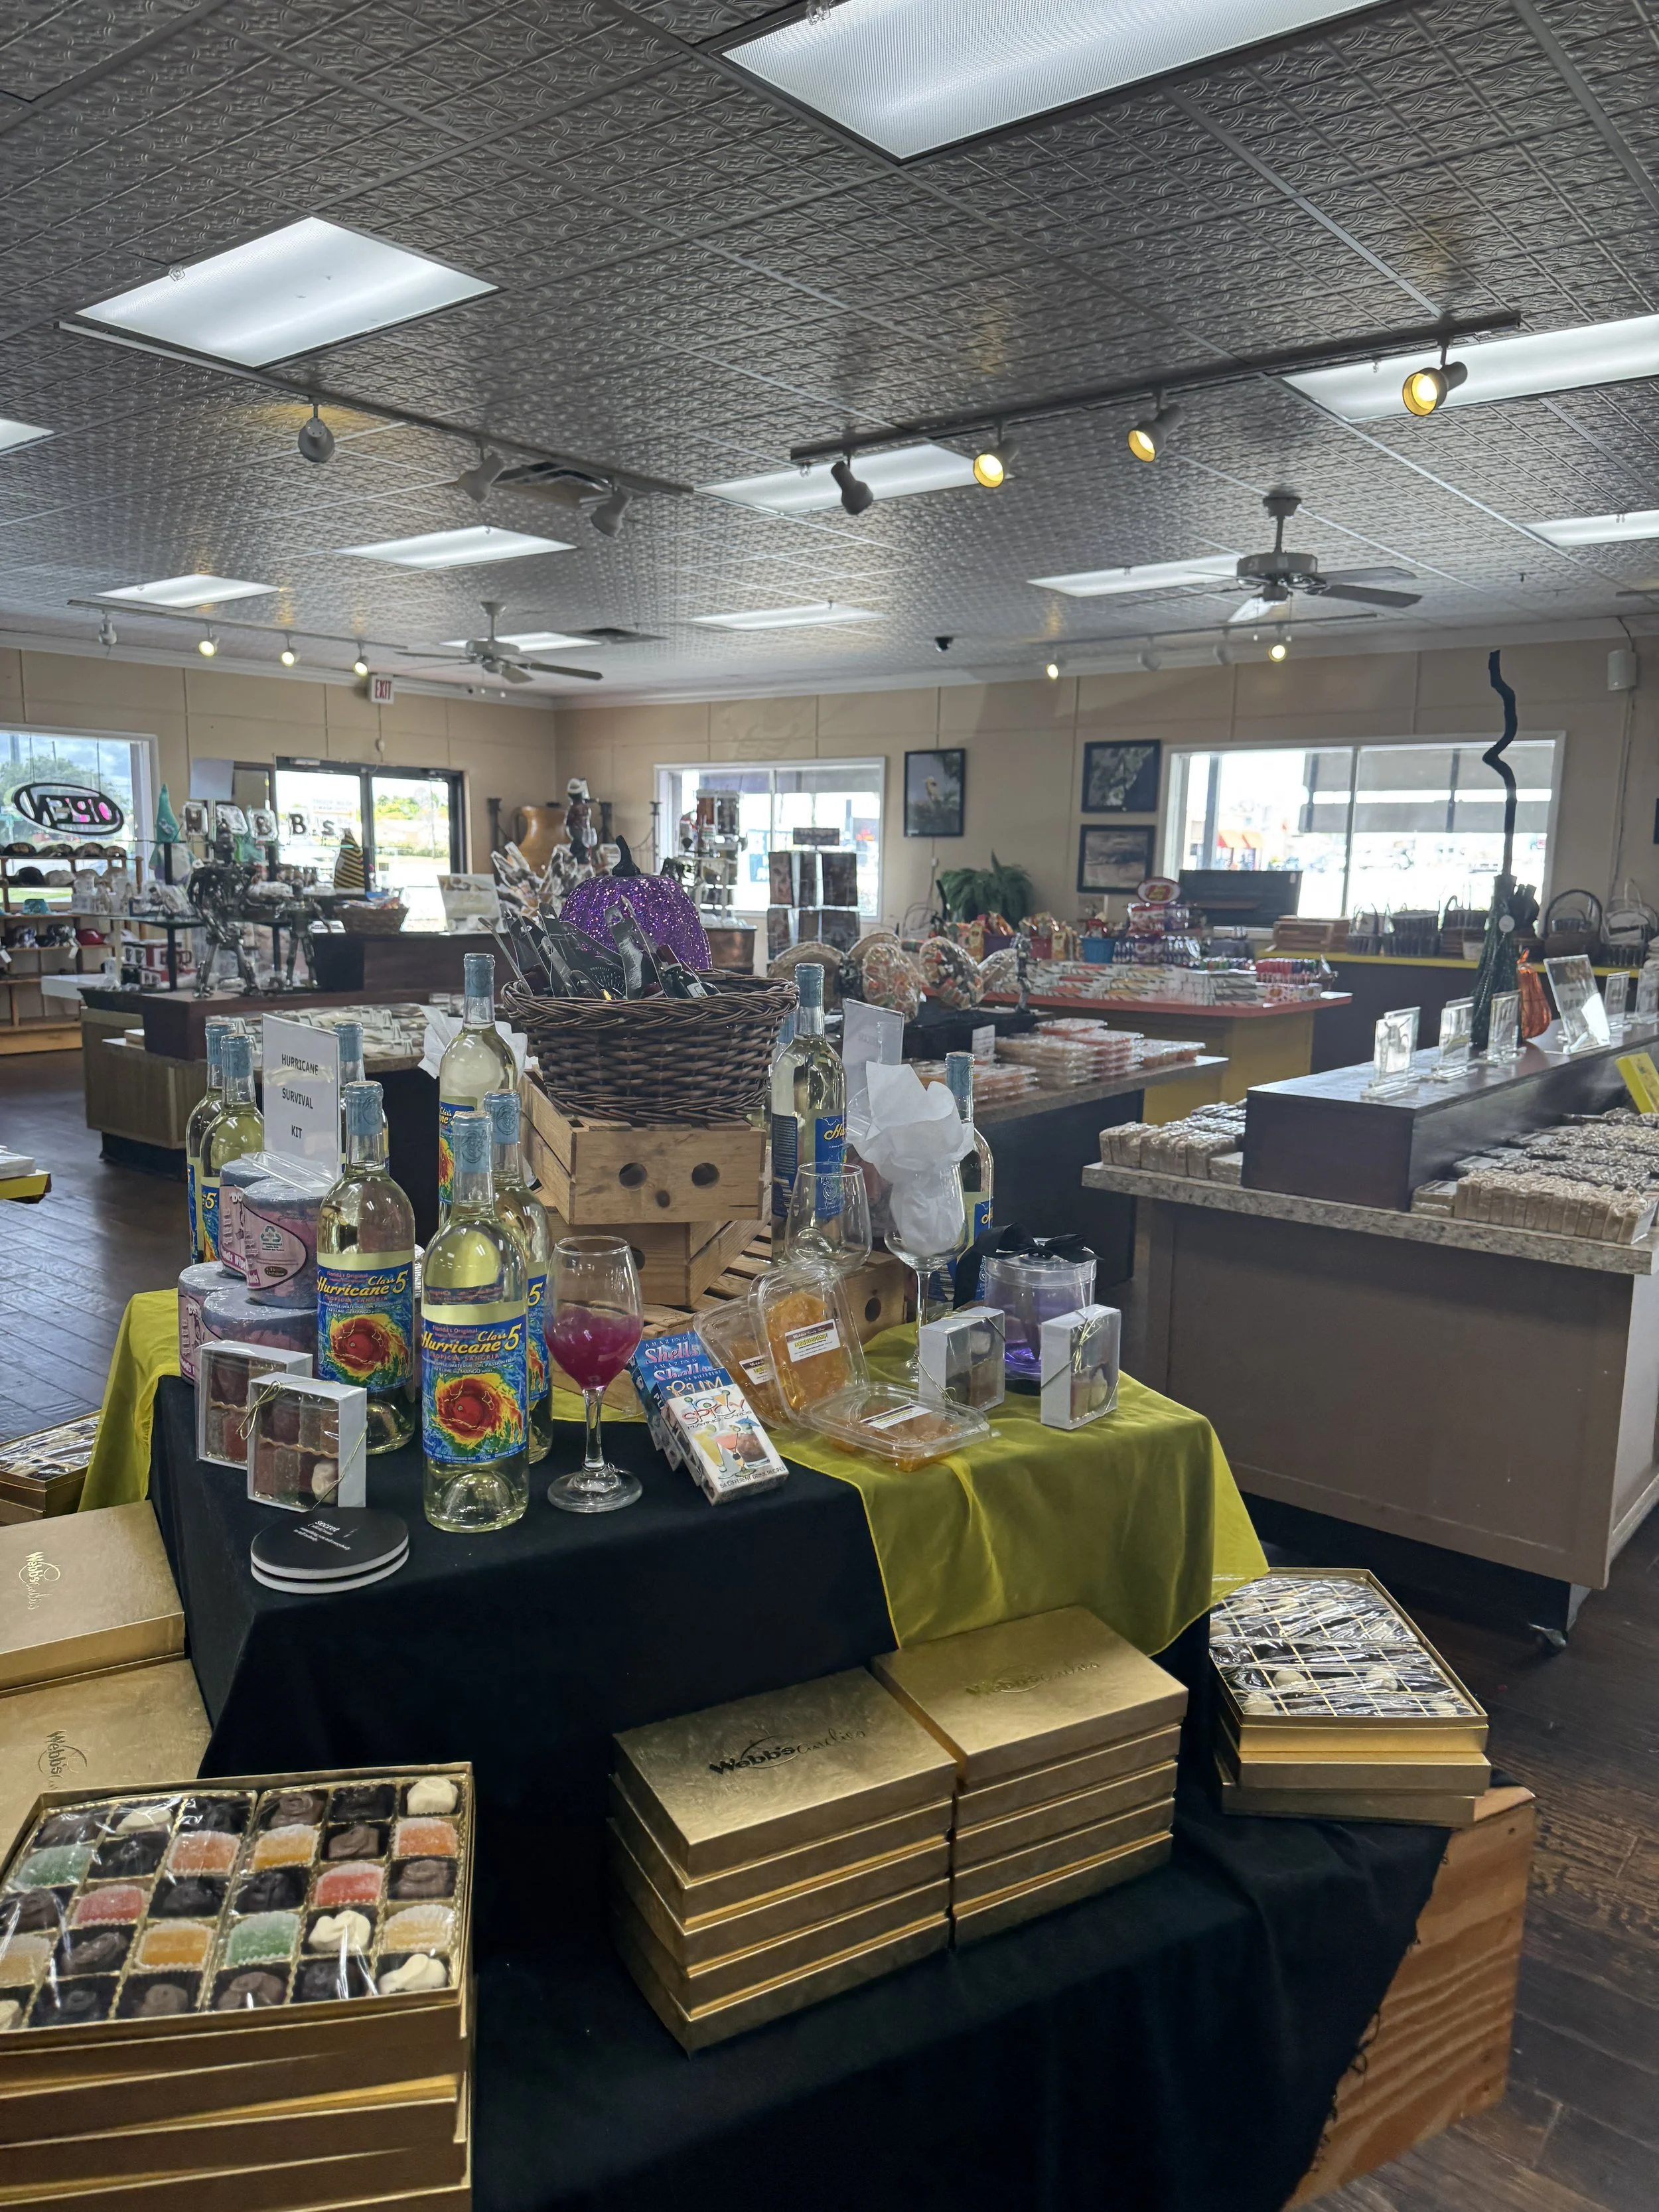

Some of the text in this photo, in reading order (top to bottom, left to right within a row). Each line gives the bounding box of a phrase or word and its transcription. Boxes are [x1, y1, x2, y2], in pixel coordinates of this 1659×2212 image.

[375, 679, 392, 700] EXIT
[281, 1053, 319, 1076] HURRICANE
[282, 1088, 313, 1109] SURVIVAL
[291, 1125, 303, 1139] KIT
[204, 1193, 217, 1209] 5
[317, 1270, 409, 1297] Hurricane 5
[368, 1276, 395, 1286] Class
[528, 1282, 543, 1306] 5
[422, 1323, 522, 1354] Hurricane 5
[478, 1331, 507, 1343] Class
[644, 1336, 687, 1349] AMAZING
[644, 1339, 699, 1365] Shells
[653, 1359, 697, 1370] AMAZING
[682, 1397, 746, 1425] SPICY
[724, 1410, 753, 1420] CARDS
[727, 1475, 752, 1486] DIFFERENT
[767, 1466, 786, 1477] RECIPES
[315, 1520, 340, 1532] secret
[26, 1551, 44, 1584] Webb's
[46, 1729, 67, 1775] Webb's
[709, 1746, 796, 1775] Webb's
